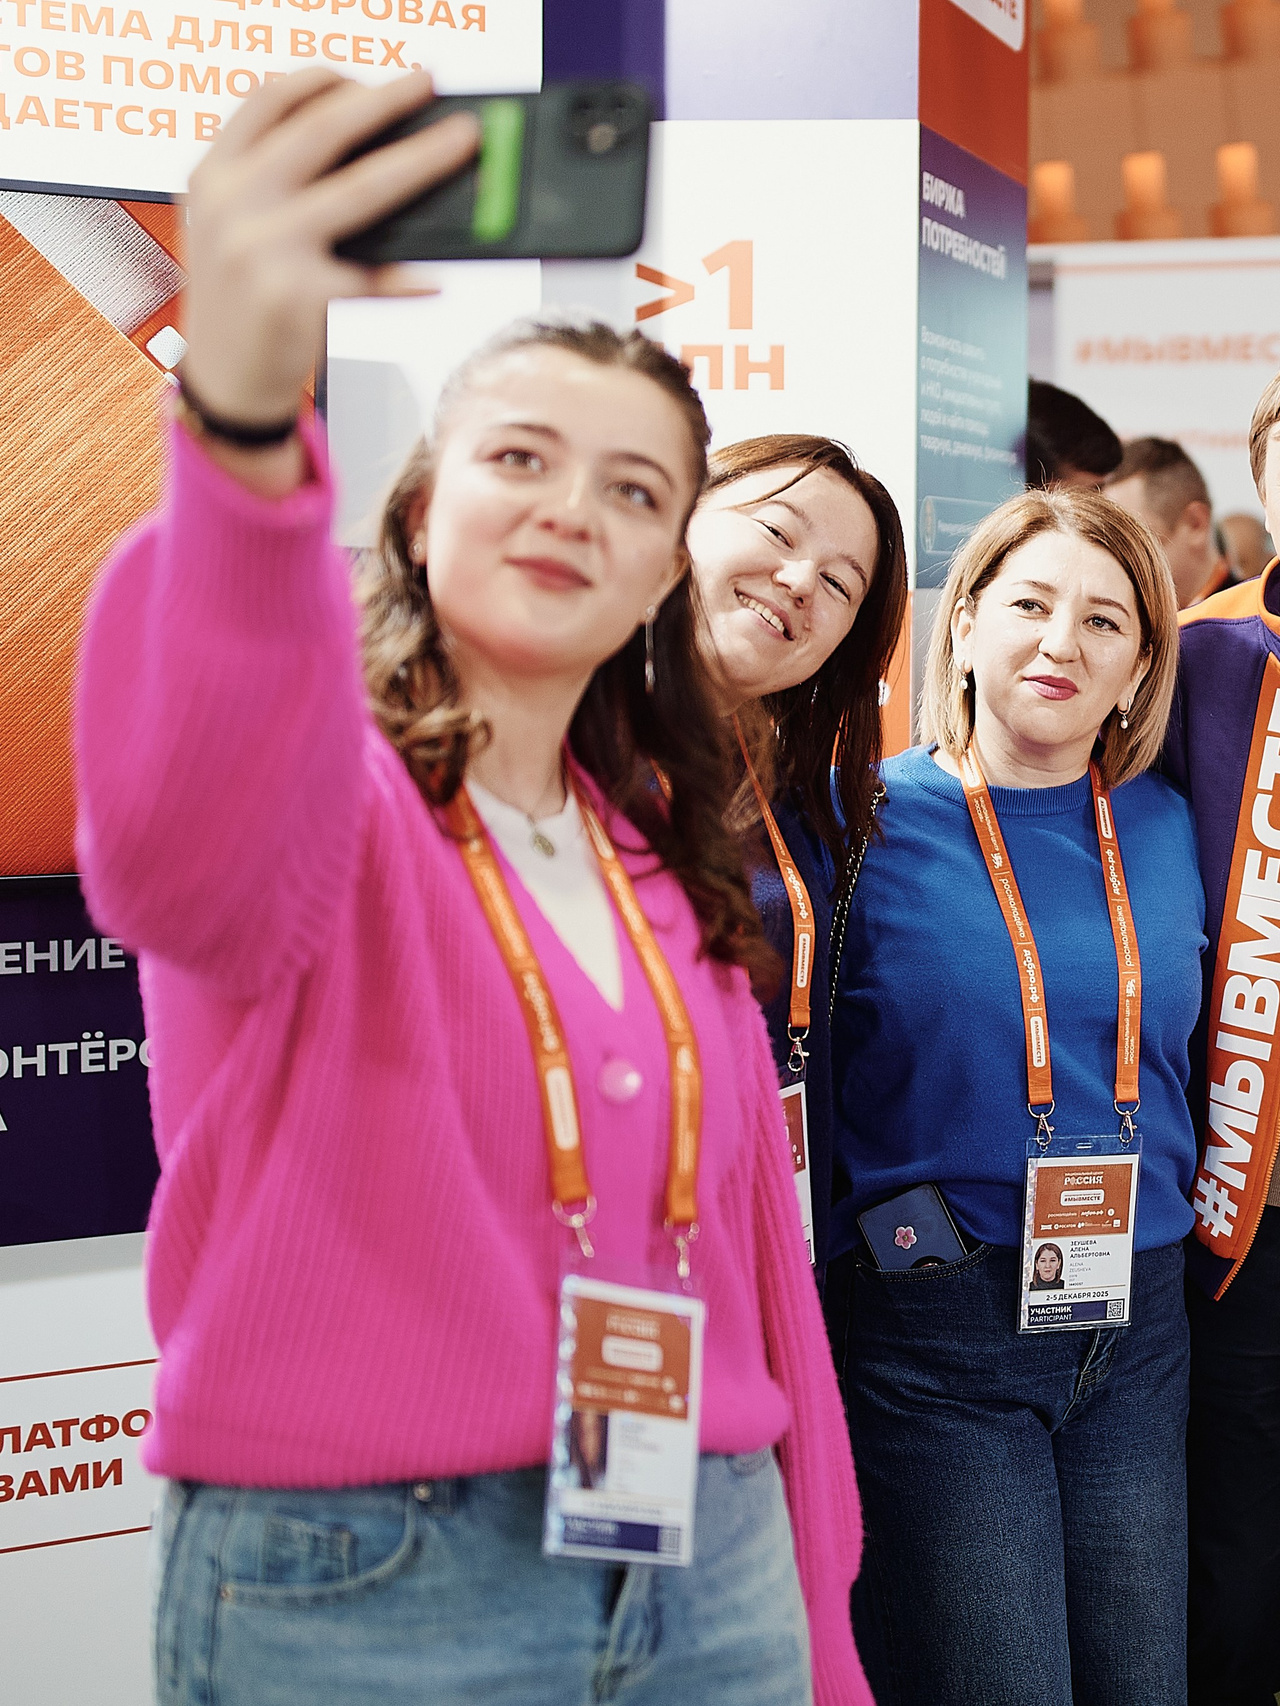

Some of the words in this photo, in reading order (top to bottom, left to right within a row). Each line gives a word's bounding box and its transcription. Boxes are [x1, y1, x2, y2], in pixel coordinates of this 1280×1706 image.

[0, 0, 152, 41] ТЕМА
[167, 14, 273, 54] ДЛЯ
[290, 28, 422, 73] ВСЕХ,
[922, 170, 966, 219] БИРЖА
[922, 215, 1006, 280] ПОТРЕБНОСТЕЙ
[1106, 849, 1120, 895] добро.рф
[1023, 949, 1040, 1003] добро.рф
[0, 1031, 153, 1078] НТЁР
[1064, 1176, 1103, 1186] РОССИЯ
[1069, 1251, 1110, 1259] АЛЬБЕРТОВНА
[1030, 1305, 1072, 1315] УЧАСТНИК
[1030, 1313, 1073, 1322] PARTICIPANT
[1058, 1292, 1091, 1301] ДЕКАБРЯ
[1092, 1290, 1109, 1298] 2025
